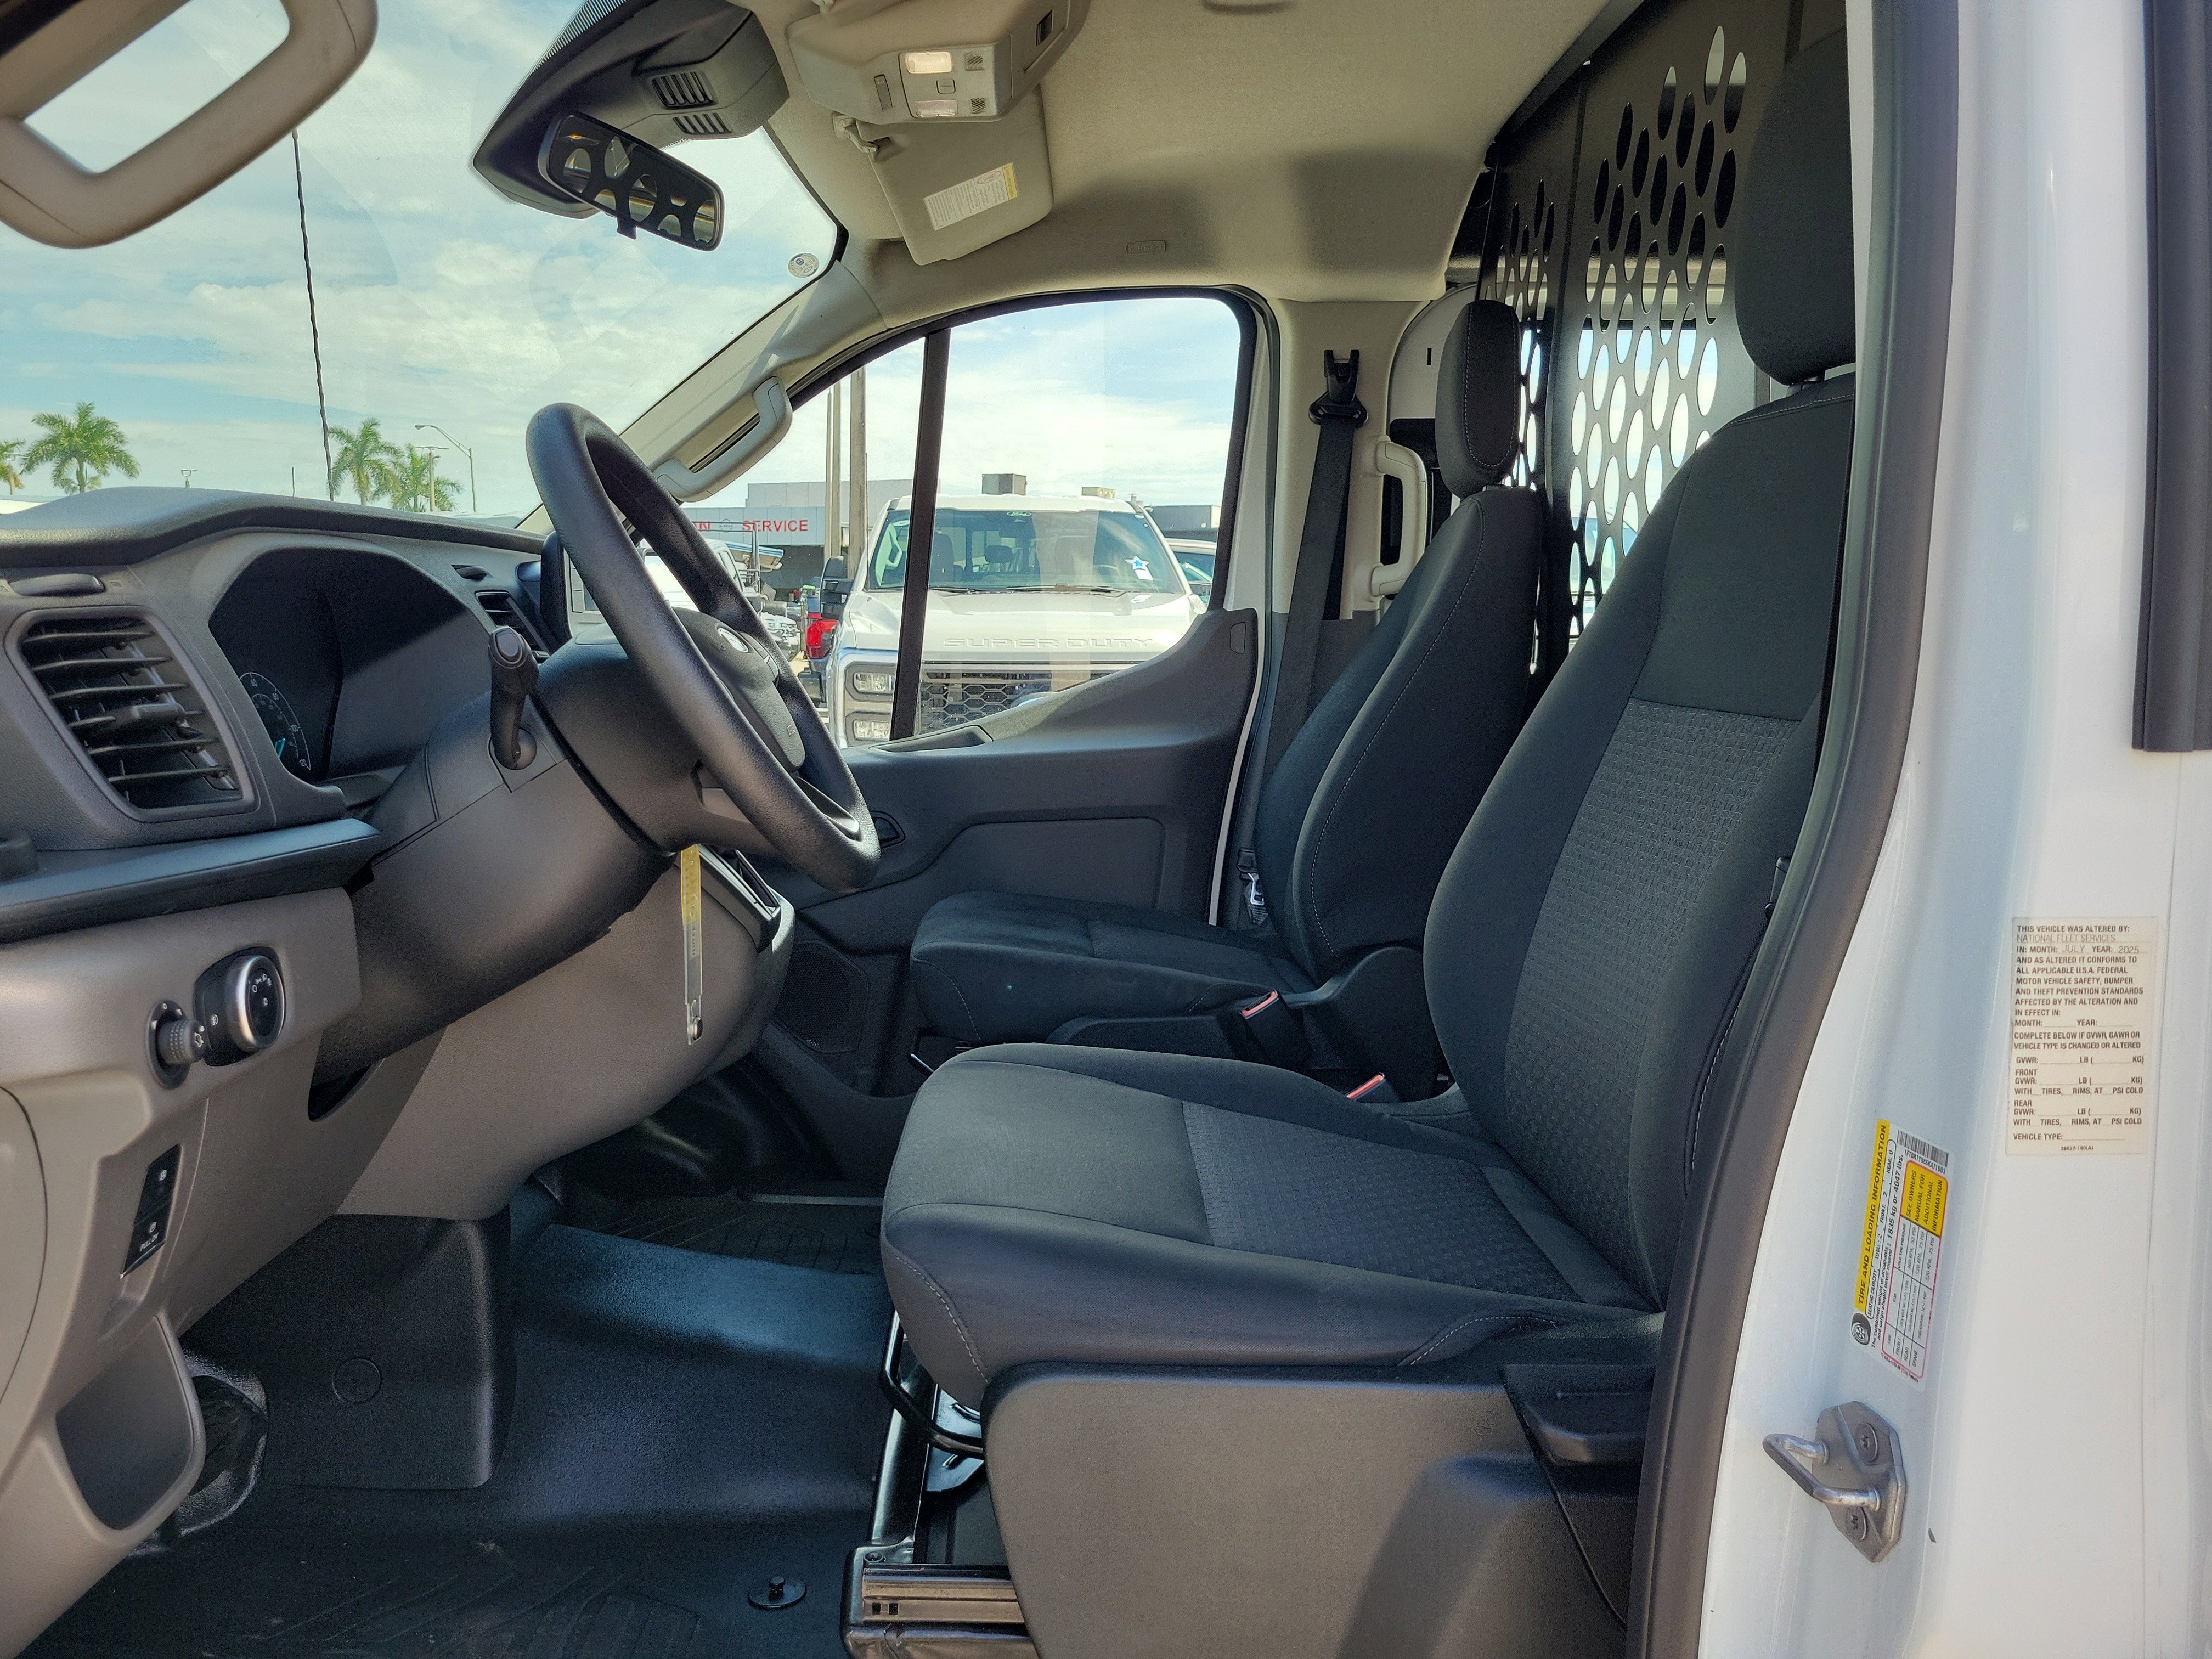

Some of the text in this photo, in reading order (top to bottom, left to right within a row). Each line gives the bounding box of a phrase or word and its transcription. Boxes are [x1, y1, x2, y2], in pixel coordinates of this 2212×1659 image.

[742, 520, 808, 532] SERVICE
[943, 637, 1152, 648] SUPER DUTY
[2074, 978, 2102, 986] SAFETY,
[1865, 1203, 1876, 1252] LOADING
[1871, 1124, 1886, 1200] INFORMATION
[1908, 1169, 1916, 1201] OWNERS
[1892, 1194, 1897, 1204] or
[1914, 1189, 1922, 1222] MANUAL
[1923, 1180, 1933, 1224] ADDITIONAL
[1931, 1178, 1943, 1231] INFORMATION
[1890, 1204, 1897, 1217] kg
[140, 1239, 151, 1251] PULL
